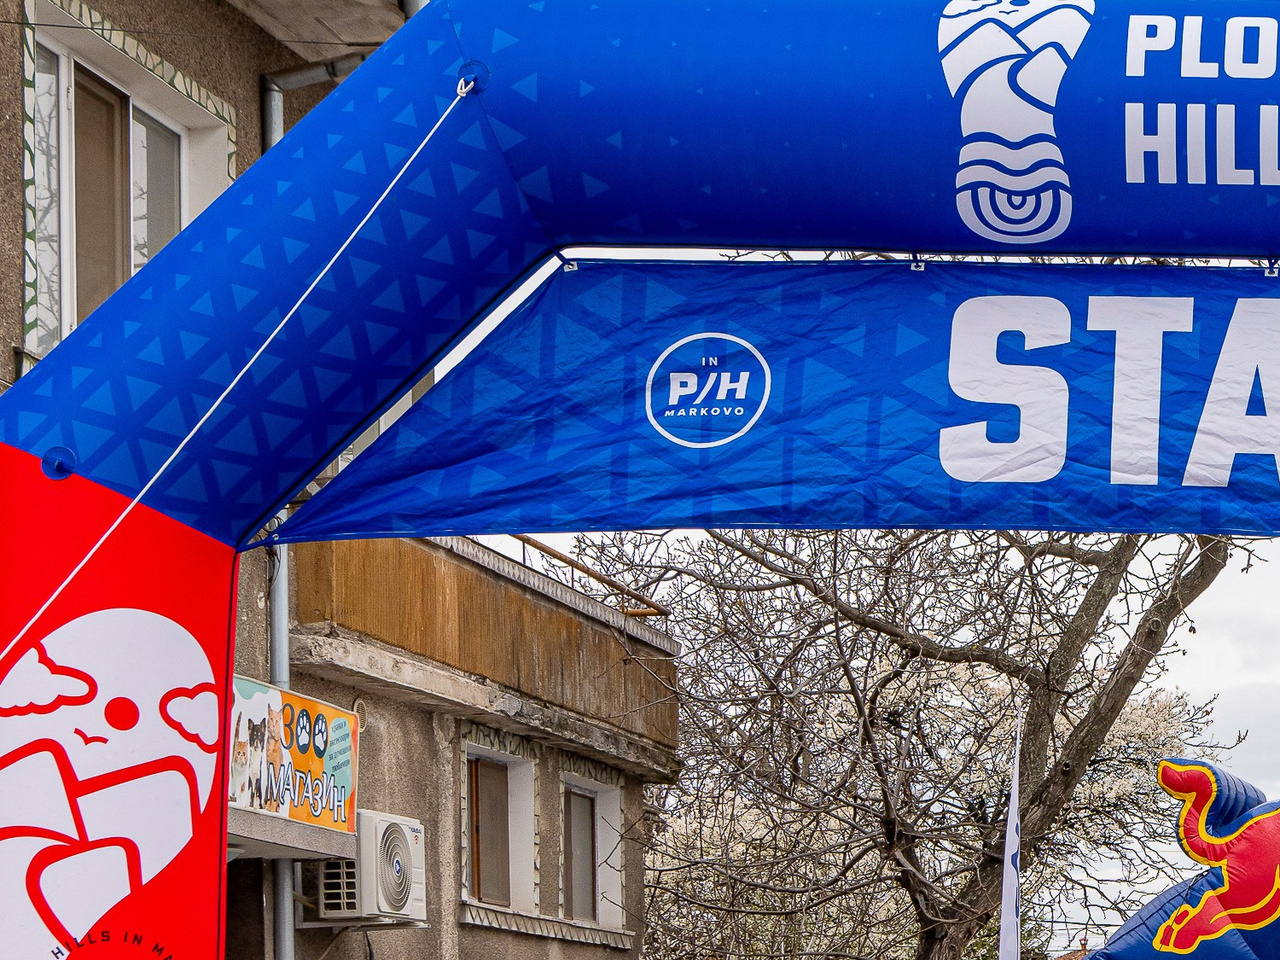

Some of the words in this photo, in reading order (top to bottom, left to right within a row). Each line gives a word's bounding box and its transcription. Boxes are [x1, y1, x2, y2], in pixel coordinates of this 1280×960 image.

[701, 356, 718, 366] IN
[668, 371, 750, 406] P/H
[664, 406, 745, 417] MARKOVO
[267, 761, 346, 823] МАГАЗИН
[51, 930, 110, 960] HILLS
[124, 931, 144, 946] IN
